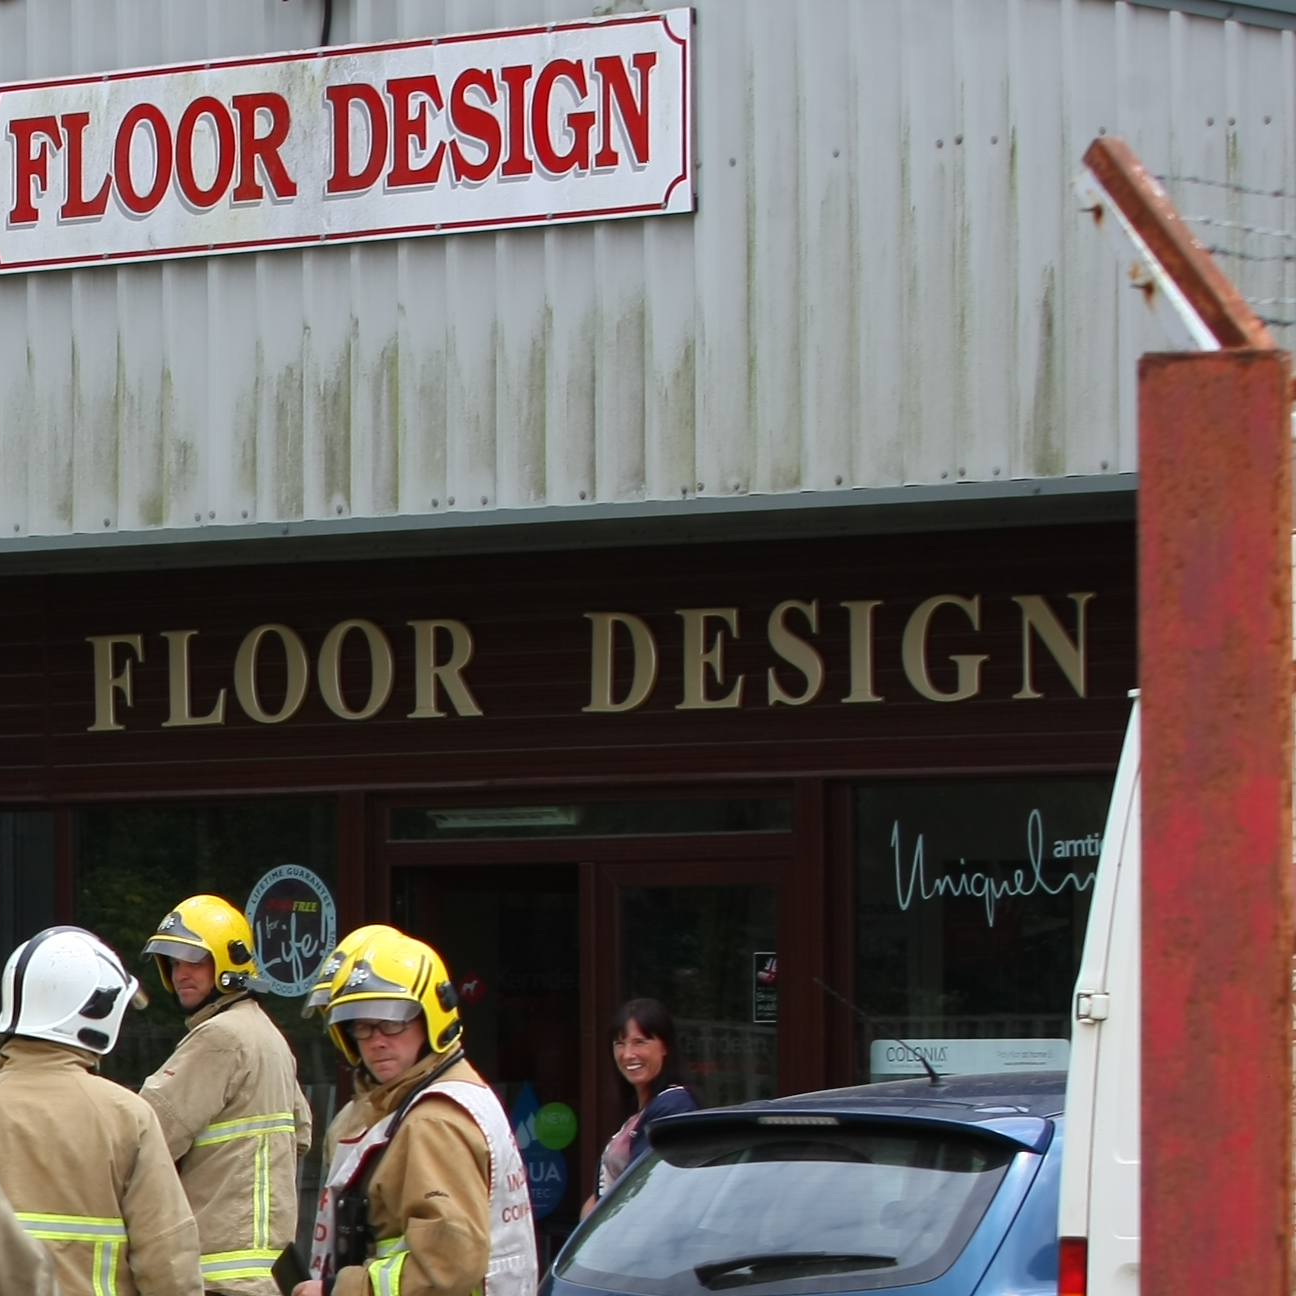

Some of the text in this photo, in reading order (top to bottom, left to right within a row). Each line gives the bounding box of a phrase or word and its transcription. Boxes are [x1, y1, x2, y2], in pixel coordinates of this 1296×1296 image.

[8, 51, 658, 226] FLOOR DESIGN
[85, 592, 1097, 732] FLOOR DESIGN
[540, 1111, 573, 1125] NEW
[528, 1162, 561, 1183] UA
